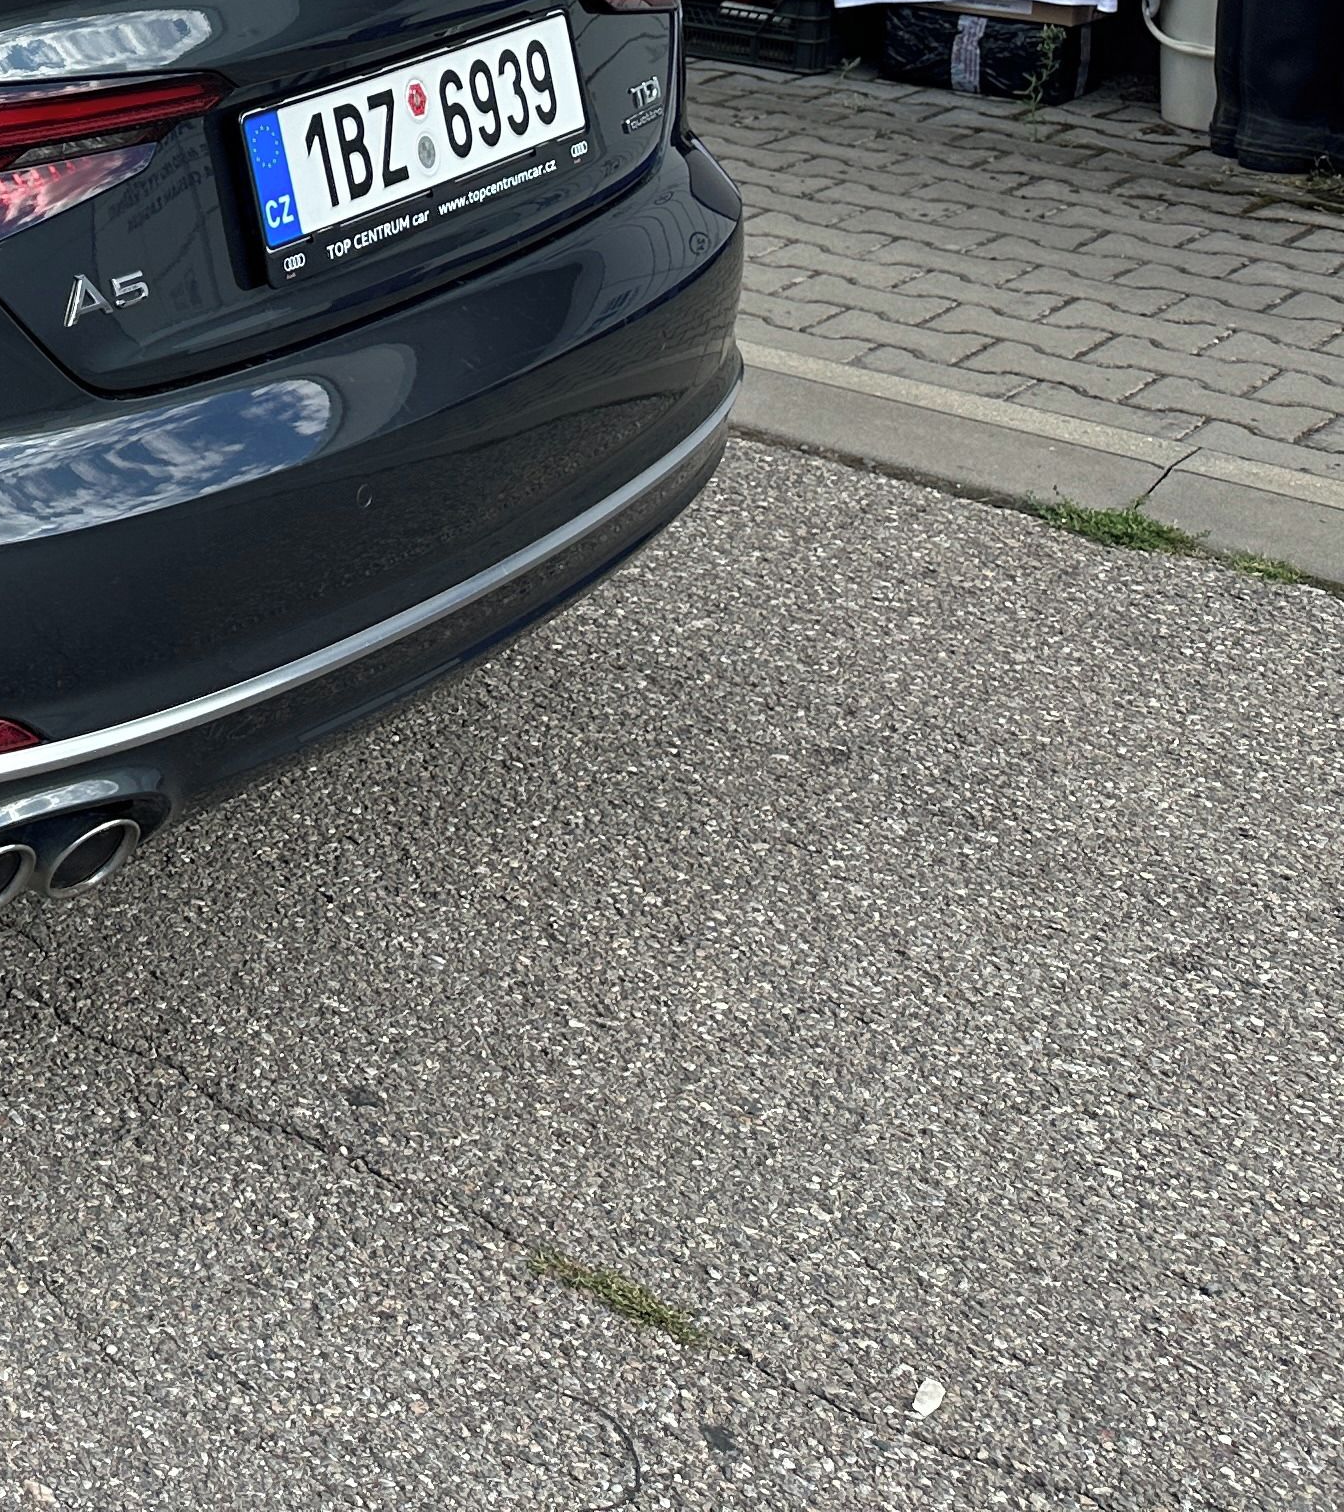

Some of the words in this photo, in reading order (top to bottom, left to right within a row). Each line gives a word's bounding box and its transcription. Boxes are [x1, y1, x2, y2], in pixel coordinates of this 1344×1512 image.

[628, 76, 661, 107] TDI
[305, 88, 410, 208] 1BZ
[439, 39, 558, 159] 6939
[631, 107, 663, 130] quattro
[265, 195, 295, 229] CZ
[326, 240, 352, 260] TOP
[353, 214, 411, 250] CENTRUM
[412, 210, 430, 227] car
[438, 160, 557, 216] www.topcentrumcar.cz
[64, 270, 149, 327] A5
